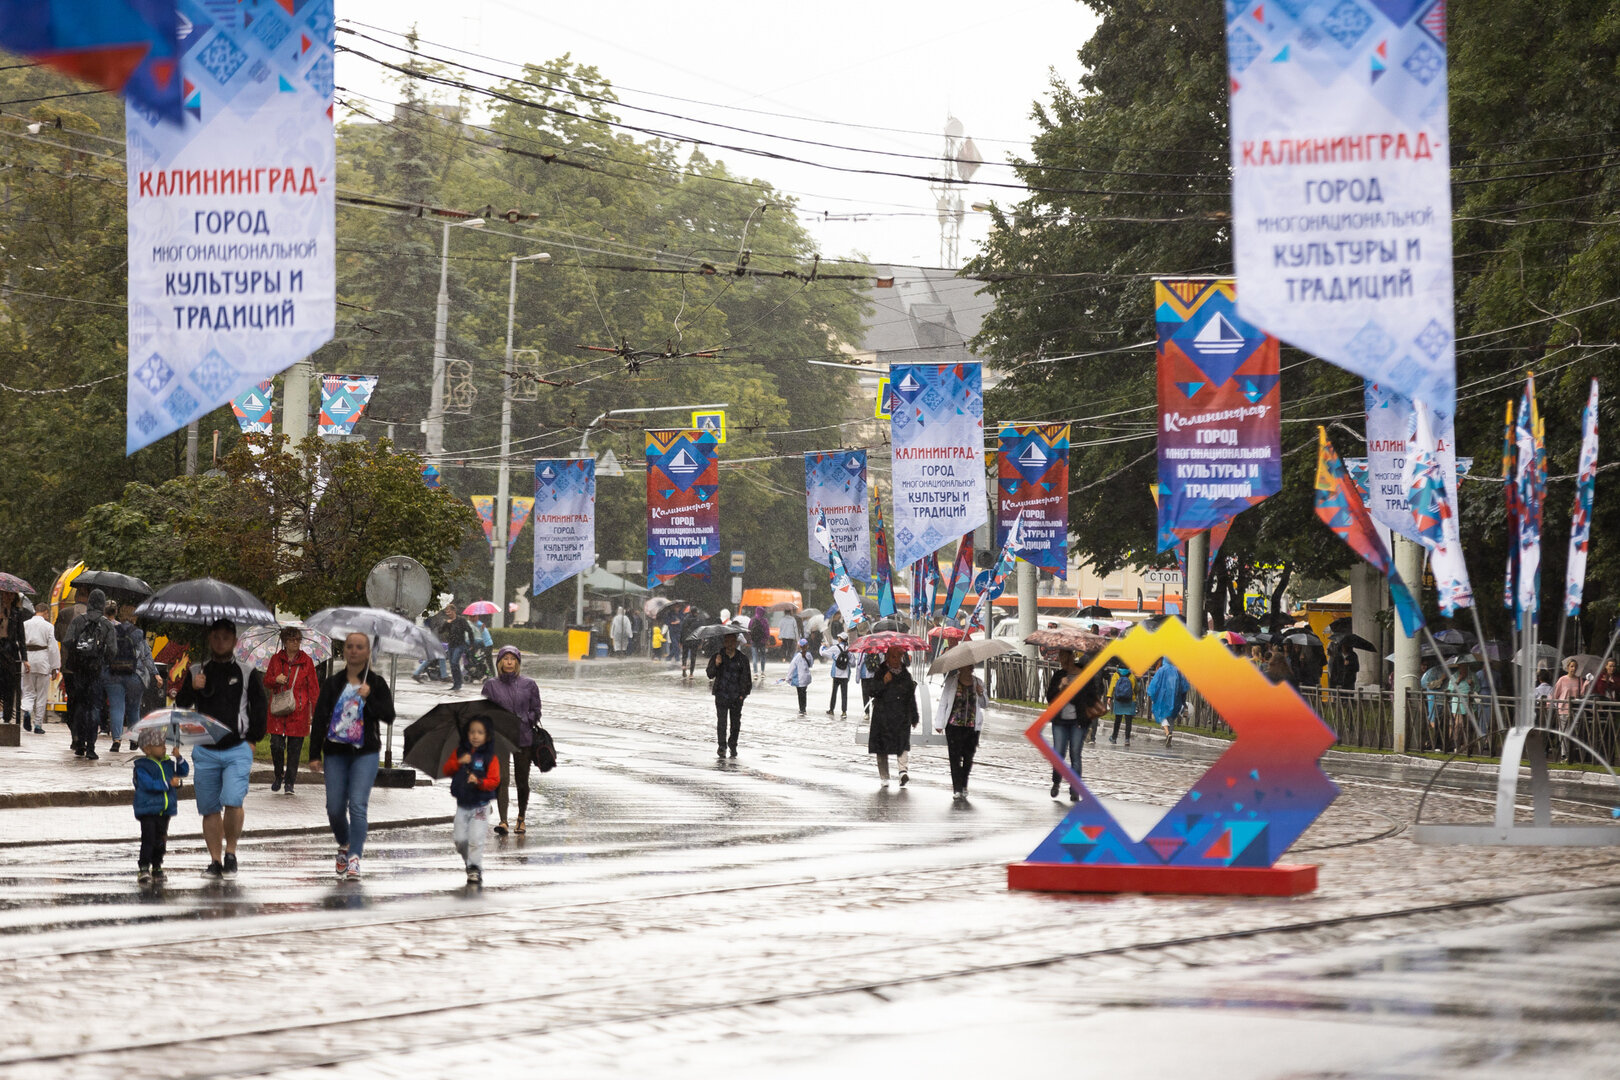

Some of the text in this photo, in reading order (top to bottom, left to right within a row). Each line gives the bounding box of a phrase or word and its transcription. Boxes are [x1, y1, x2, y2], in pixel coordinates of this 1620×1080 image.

[1241, 131, 1442, 167] КАЛИНИНГРАД-
[139, 166, 327, 197] КАЛИНИНГРАД-
[1305, 177, 1385, 205] ГОРОД
[194, 209, 270, 236] ГОРОД
[1257, 207, 1435, 233] МНОГОНАЦИОНАЛЬНОЙ
[152, 239, 317, 264] МНОГОНАЦИОНАЛЬНОЙ
[1273, 238, 1421, 268] КУЛЬТУРЫ И
[165, 269, 303, 296] КУЛЬТУРЫ И
[1285, 269, 1414, 303] ТРАДИЦИЙ
[173, 299, 295, 331] ТРАДИЦИЙ
[1164, 405, 1272, 432] Калининград-
[1196, 429, 1238, 446] ГОРОД
[895, 446, 980, 460] КАЛИНИНГРАД-
[1165, 446, 1271, 461] МНОГОНАЦИОНАЛЬНОЙ
[922, 465, 955, 477] ГОРОД
[1177, 464, 1259, 479] КУЛЬТУРЫ И
[902, 478, 976, 488] МНОГОНАЦИОНАЛЬНОЙ
[1185, 481, 1251, 500] ТРАДИЦИЙ
[908, 491, 970, 503] КУЛЬТУРЫ И
[1002, 496, 1063, 511] Калининград-
[652, 502, 714, 519] Калининград-
[913, 504, 967, 519] ТРАДИЦИЙ
[536, 514, 592, 523] КАЛИНИНГРАД-
[671, 516, 695, 526] ГОРОД
[553, 526, 575, 534] ГОРОД
[652, 526, 714, 535] МНОГОНАЦИОНАЛЬНОЙ
[1049, 529, 1055, 538] И
[660, 536, 707, 546] КУЛЬТУРЫ И
[834, 534, 853, 542] ТУРЫ
[546, 552, 582, 561] ТРАДИЦИЙ
[664, 547, 703, 559] ТРАДИЦИЙ
[1149, 572, 1179, 582] СТОП
